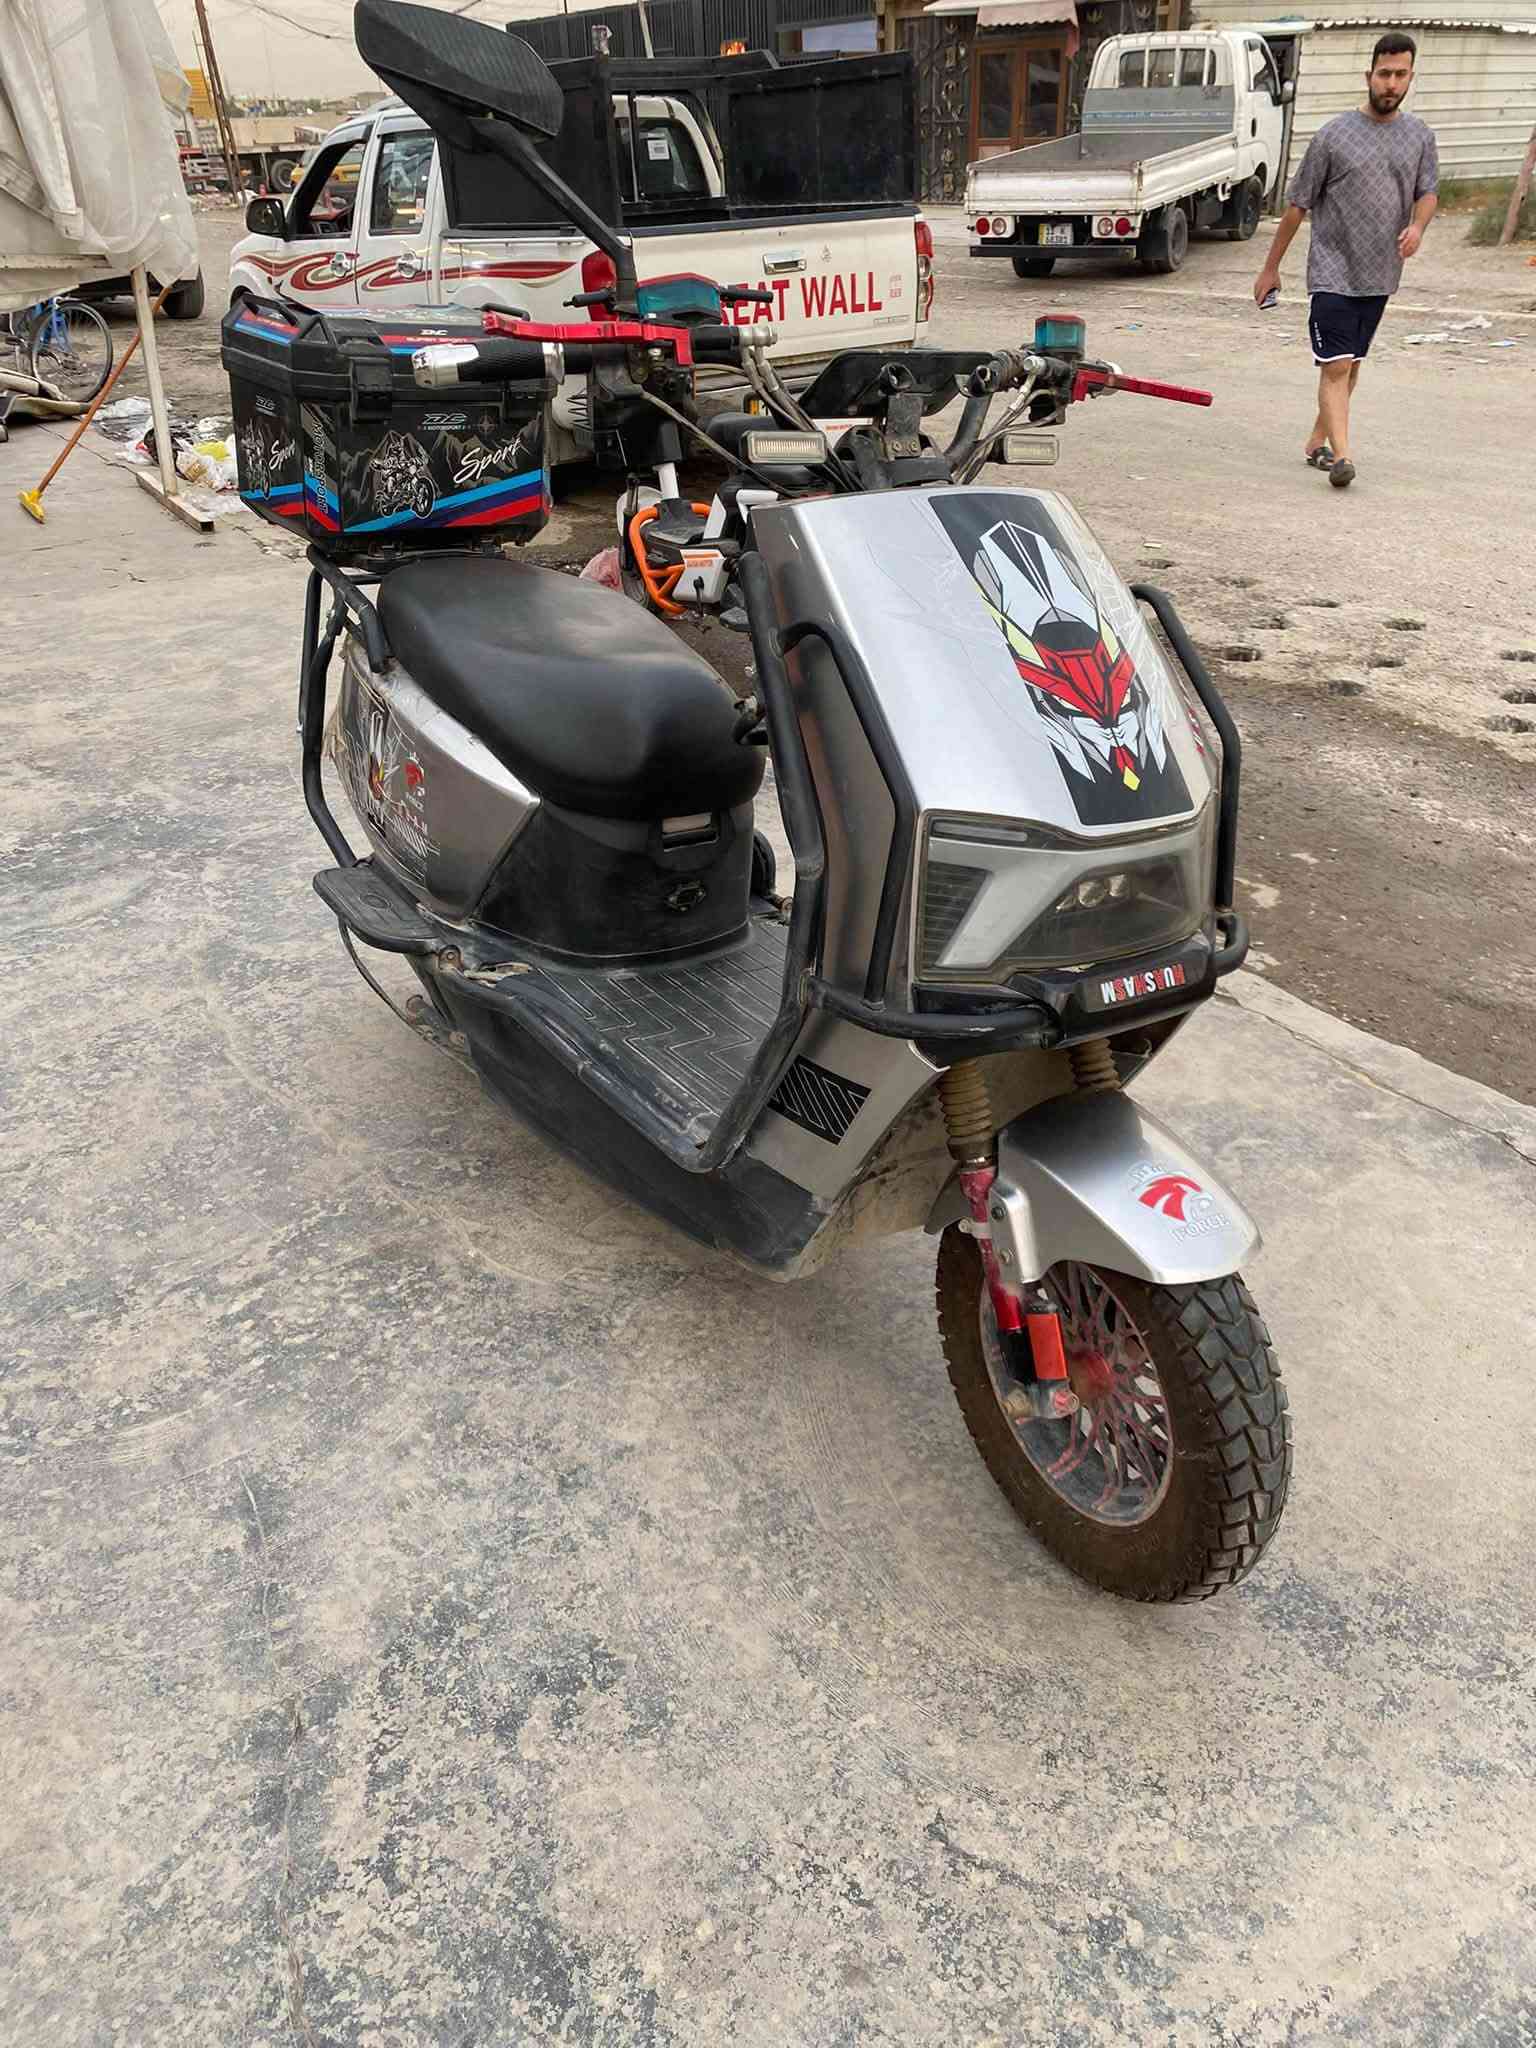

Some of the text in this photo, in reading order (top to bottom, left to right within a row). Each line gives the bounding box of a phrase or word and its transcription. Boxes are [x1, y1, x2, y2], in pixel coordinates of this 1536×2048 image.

[719, 279, 790, 326] EAT
[800, 271, 883, 319] WALL
[268, 439, 296, 471] Sport
[453, 436, 521, 484] Sport
